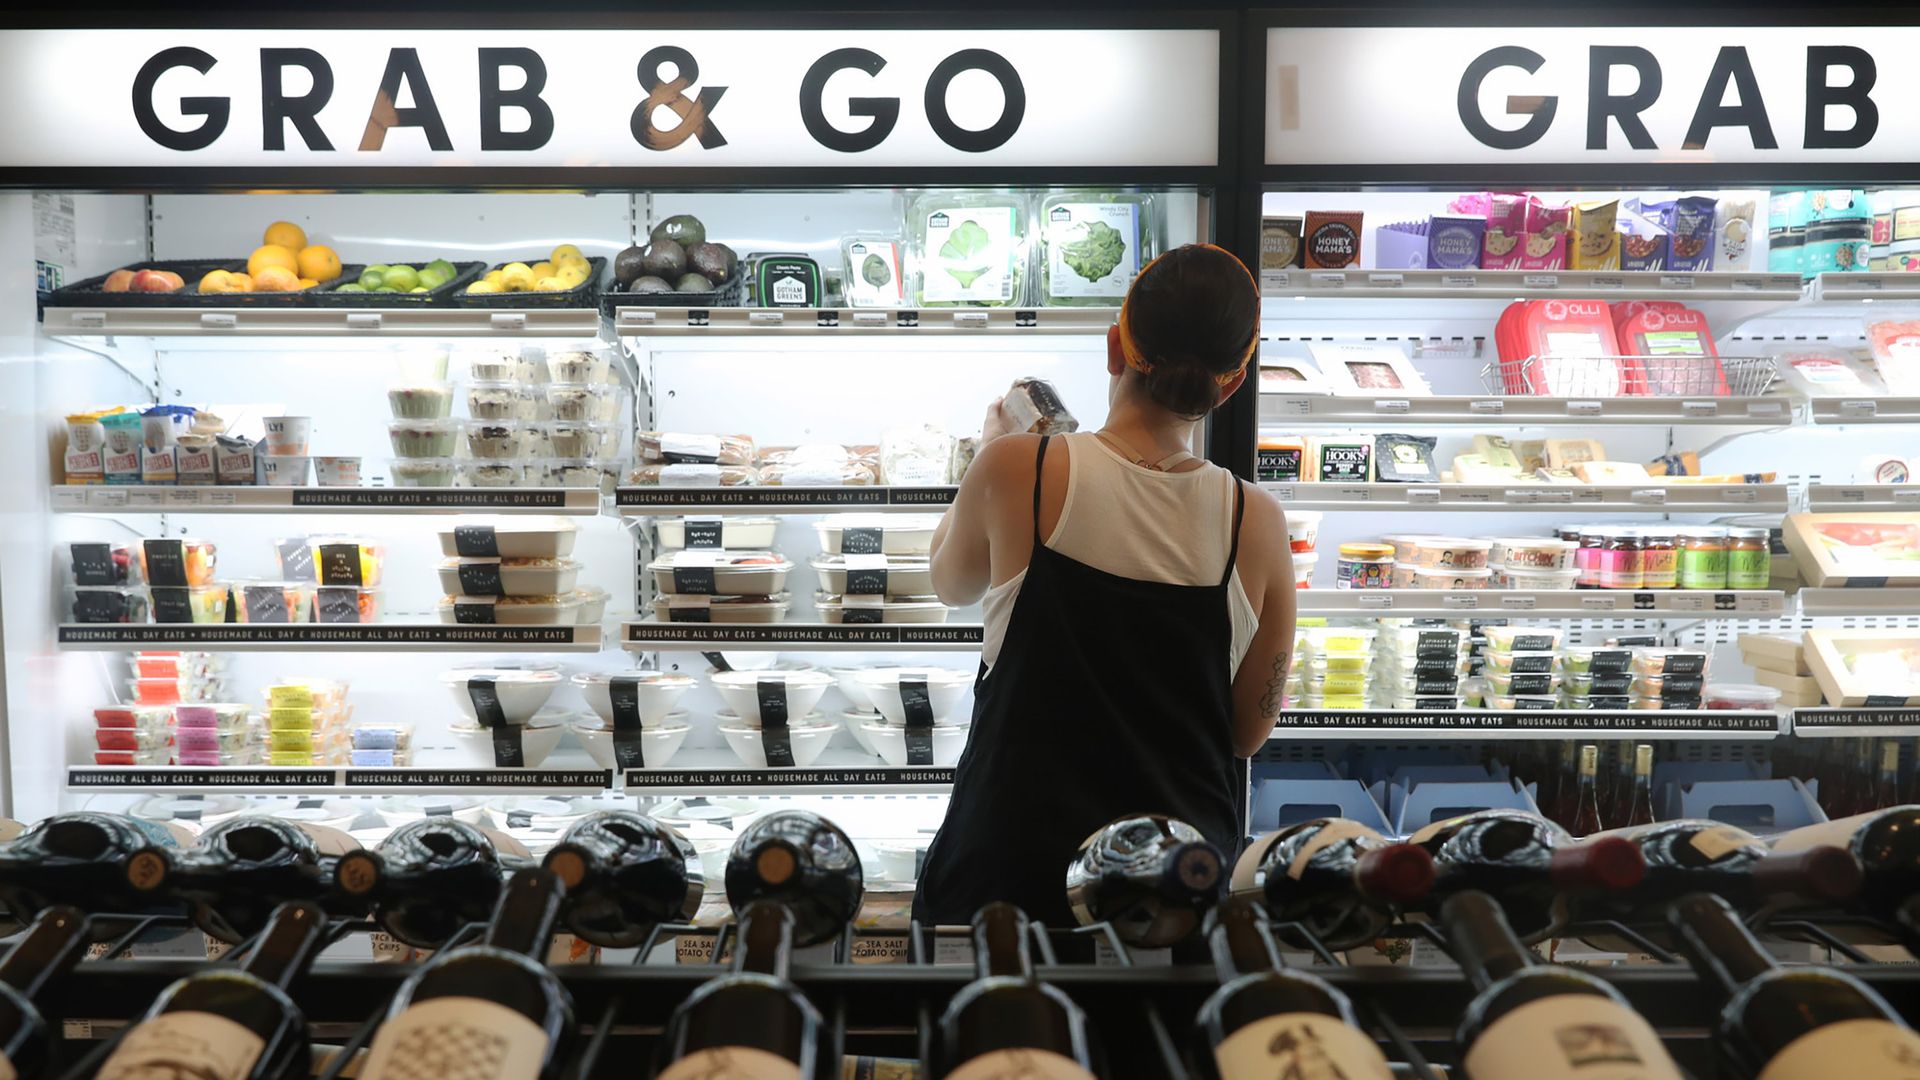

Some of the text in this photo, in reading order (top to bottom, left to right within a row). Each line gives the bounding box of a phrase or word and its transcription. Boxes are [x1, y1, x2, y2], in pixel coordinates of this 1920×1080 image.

[132, 46, 1025, 153] GRAB & GO
[1458, 46, 1879, 150] GRAB
[1263, 237, 1291, 246] ONEY
[1318, 237, 1351, 246] HONEY
[1439, 238, 1471, 246] HONEY
[1263, 245, 1291, 253] AMA'S
[1315, 245, 1353, 254] MAMA'S
[1437, 246, 1473, 255] MAMA'S
[1568, 303, 1600, 315] OLLI
[1665, 315, 1698, 325] OLLI
[299, 494, 557, 503] HOUSEMADE ALL DAY EATS HOUSEMADE ALL DAY EATS
[622, 493, 880, 503] HOUSEMADE ALL DAY EATS HOUSEMADE ALL DAY EATS
[896, 493, 948, 501] HOUSEMADE
[65, 630, 295, 640] HOUSEMADE ALL DAY EATS HOUSEMADE ALL DAY
[310, 630, 566, 639] HOUSEMADE ALL DAY EATS HOUSEMADE ALL DAY EATS
[635, 630, 891, 640] HOUSEMADE ALL DAY EATS HOUSEMADE ALL DAY EATS
[906, 631, 979, 640] HOUSEMADE ALL
[1303, 716, 1503, 725] ALL DAY EATS HOUSEMADE ALL DAY EATS
[1517, 718, 1771, 728] HOUSEMADE ALL DAY EATS HOUSEMADE ALL DAY EATS
[1801, 714, 1852, 723] HOUSEMADE
[1857, 714, 1872, 723] ALL
[1877, 714, 1894, 723] DAY
[74, 774, 328, 784] HOUSEMADE ALL DAY EATS HOUSEMADE ALL DAY EATS
[351, 774, 605, 784] HOUSEMADE ALL DAY EATS HOUSEMADE ALL DAY EATS
[633, 773, 886, 783] HOUSEMADE ALL DAY EATS HOUSEMADE ALL DAY EATS
[900, 772, 952, 781] HOUSEMADE
[379, 943, 400, 952] CHIPS
[684, 940, 715, 949] SEA SAL
[866, 940, 903, 948] SEA SALT
[679, 949, 703, 957] OTATO
